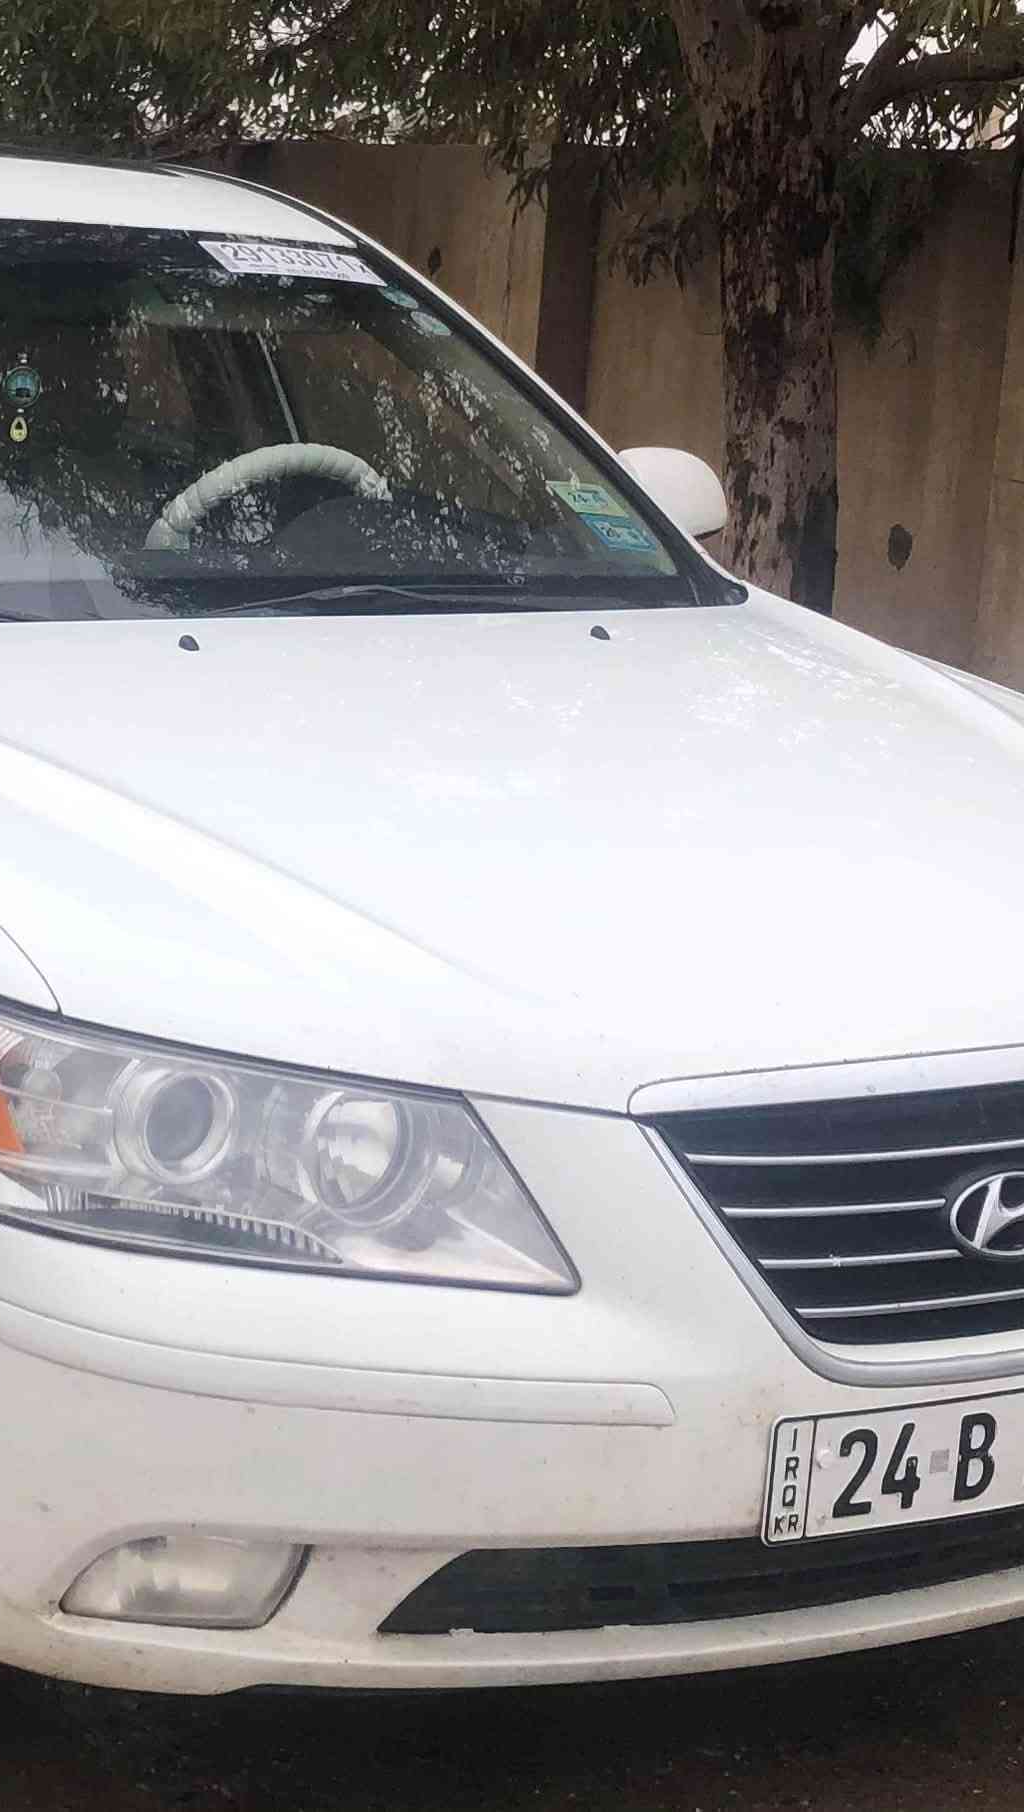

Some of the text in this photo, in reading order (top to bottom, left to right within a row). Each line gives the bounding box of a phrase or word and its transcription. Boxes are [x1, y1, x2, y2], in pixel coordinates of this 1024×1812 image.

[831, 1412, 997, 1518] 24 B
[773, 1513, 800, 1535] KR
